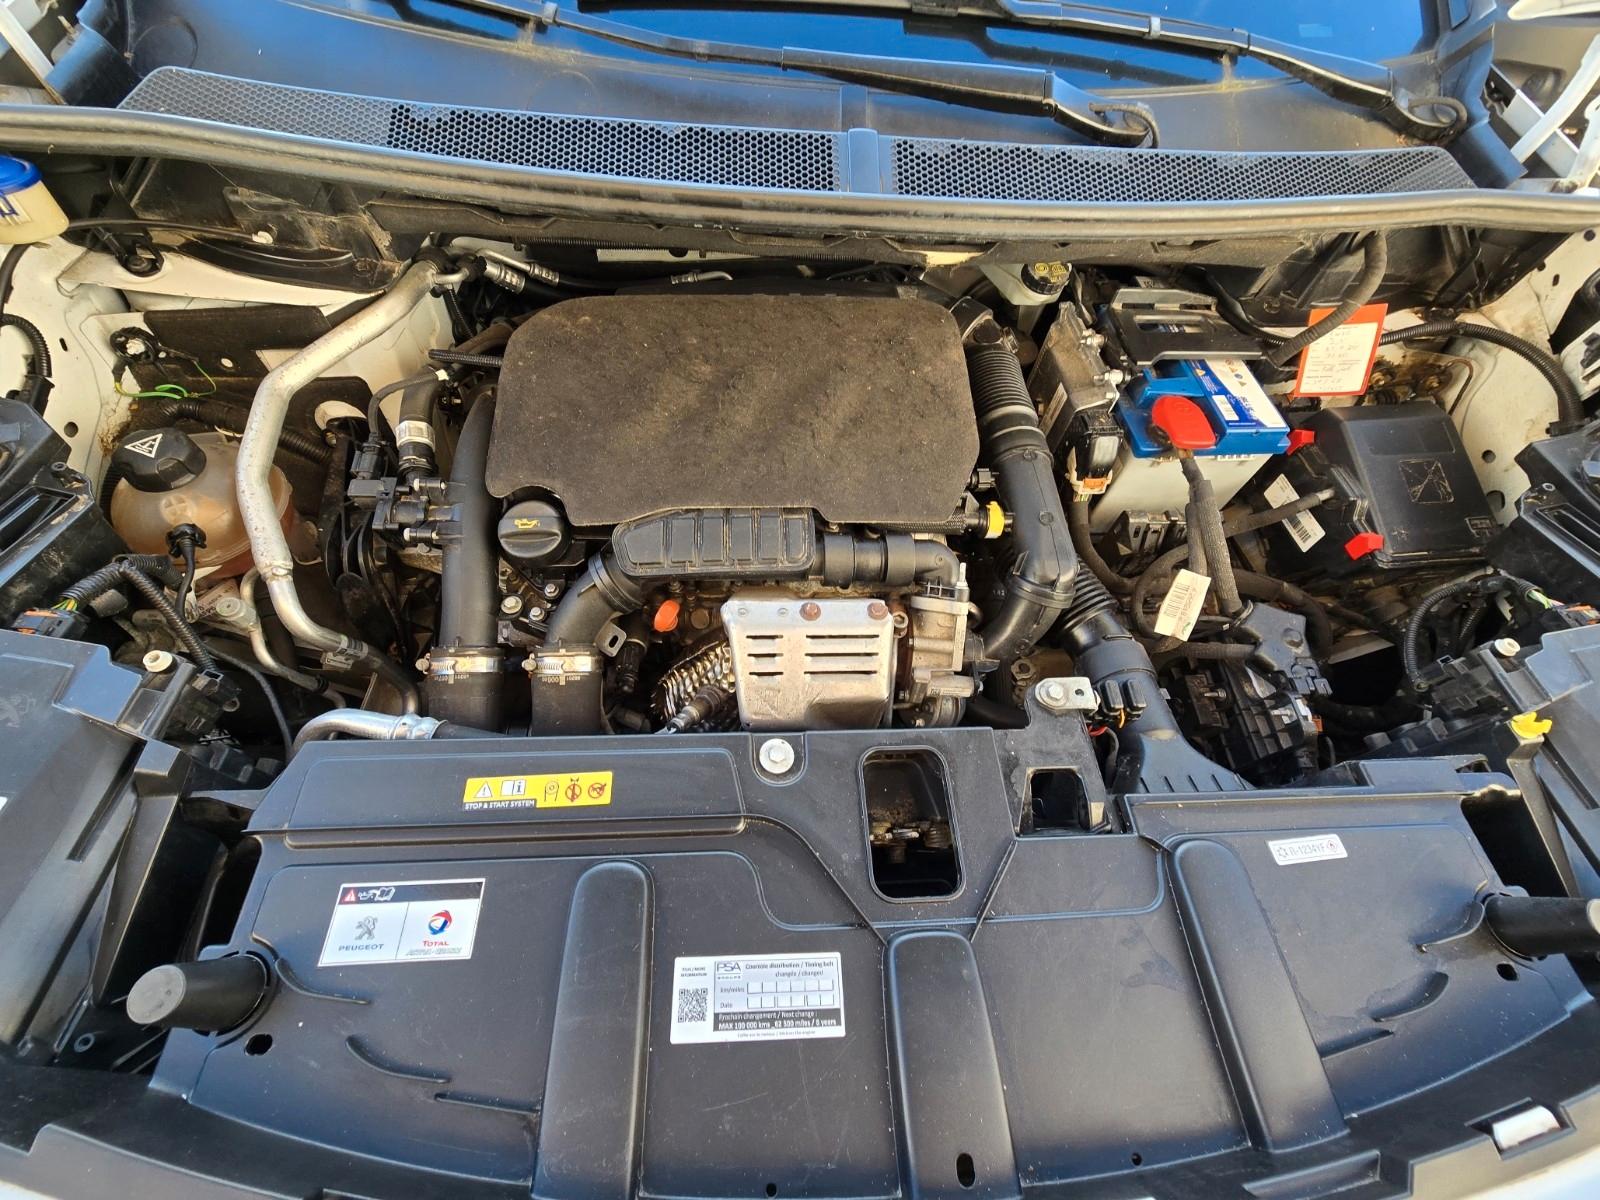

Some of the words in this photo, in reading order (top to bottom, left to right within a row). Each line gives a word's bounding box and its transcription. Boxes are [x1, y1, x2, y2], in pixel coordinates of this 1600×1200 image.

[465, 802, 482, 810] STOP
[489, 800, 509, 809] START
[510, 799, 535, 808] SYSTEM
[338, 943, 384, 952] PEUGEOT
[716, 962, 742, 972] PSA
[805, 961, 822, 969] Timing
[720, 1001, 733, 1009] Date
[718, 1022, 734, 1030] MAX
[735, 1022, 746, 1030] 100
